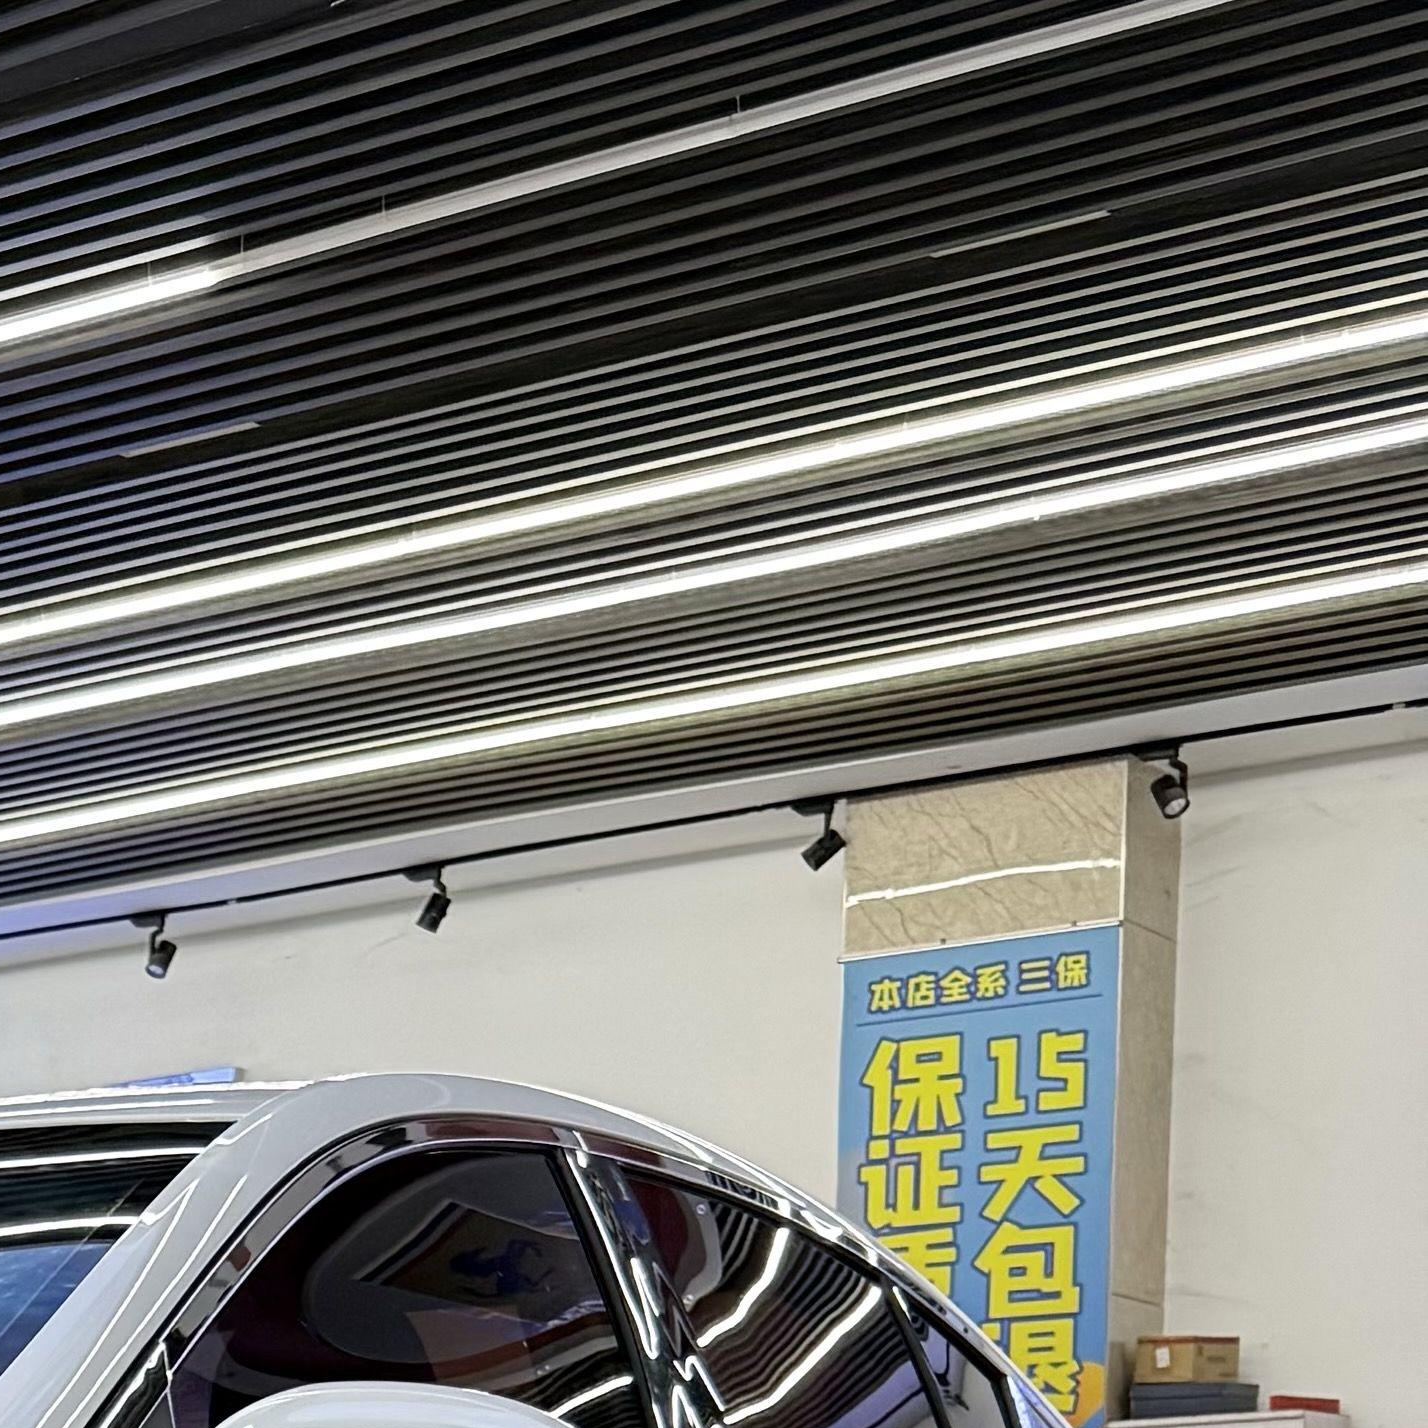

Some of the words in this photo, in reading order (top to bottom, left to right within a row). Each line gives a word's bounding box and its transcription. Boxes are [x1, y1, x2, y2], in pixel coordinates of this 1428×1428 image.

[870, 963, 1006, 1012] 本店全系
[1019, 954, 1089, 992] 三保
